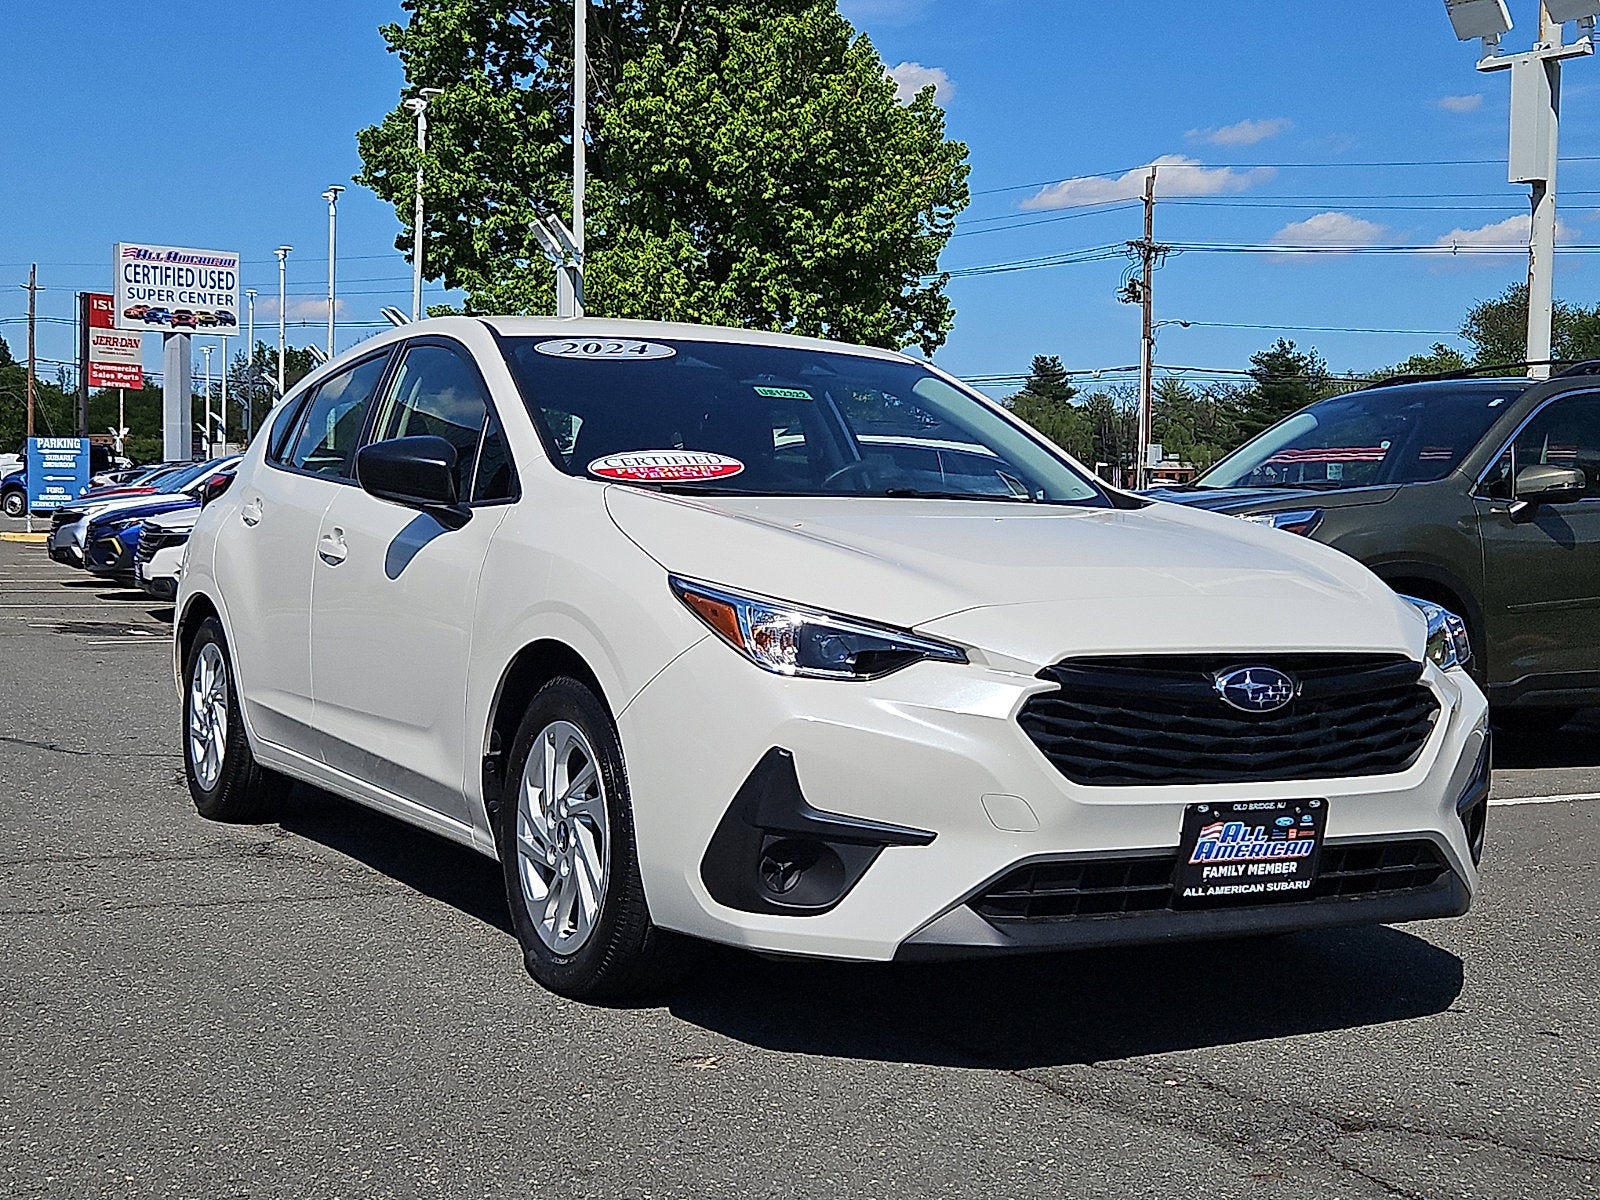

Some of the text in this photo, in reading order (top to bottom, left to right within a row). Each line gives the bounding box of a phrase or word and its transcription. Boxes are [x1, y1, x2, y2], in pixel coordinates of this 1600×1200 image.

[124, 263, 236, 291] CERTIFIED USED
[127, 287, 234, 306] SUPER CENTER
[560, 342, 649, 355] 2024
[93, 363, 139, 373] Commercial
[92, 371, 140, 381] Sales Parts
[101, 379, 131, 388] Service
[36, 438, 81, 449] PARKING
[603, 454, 722, 468] CERTIFIED
[615, 465, 723, 475] PRE-OWNED
[635, 469, 714, 479] VEHICLE
[1220, 821, 1268, 845] ALL
[1191, 839, 1315, 863] AMERICAN
[1203, 862, 1297, 878] FAMILY MEMBER
[1183, 879, 1311, 897] ALL AMERICAN SUBARU
